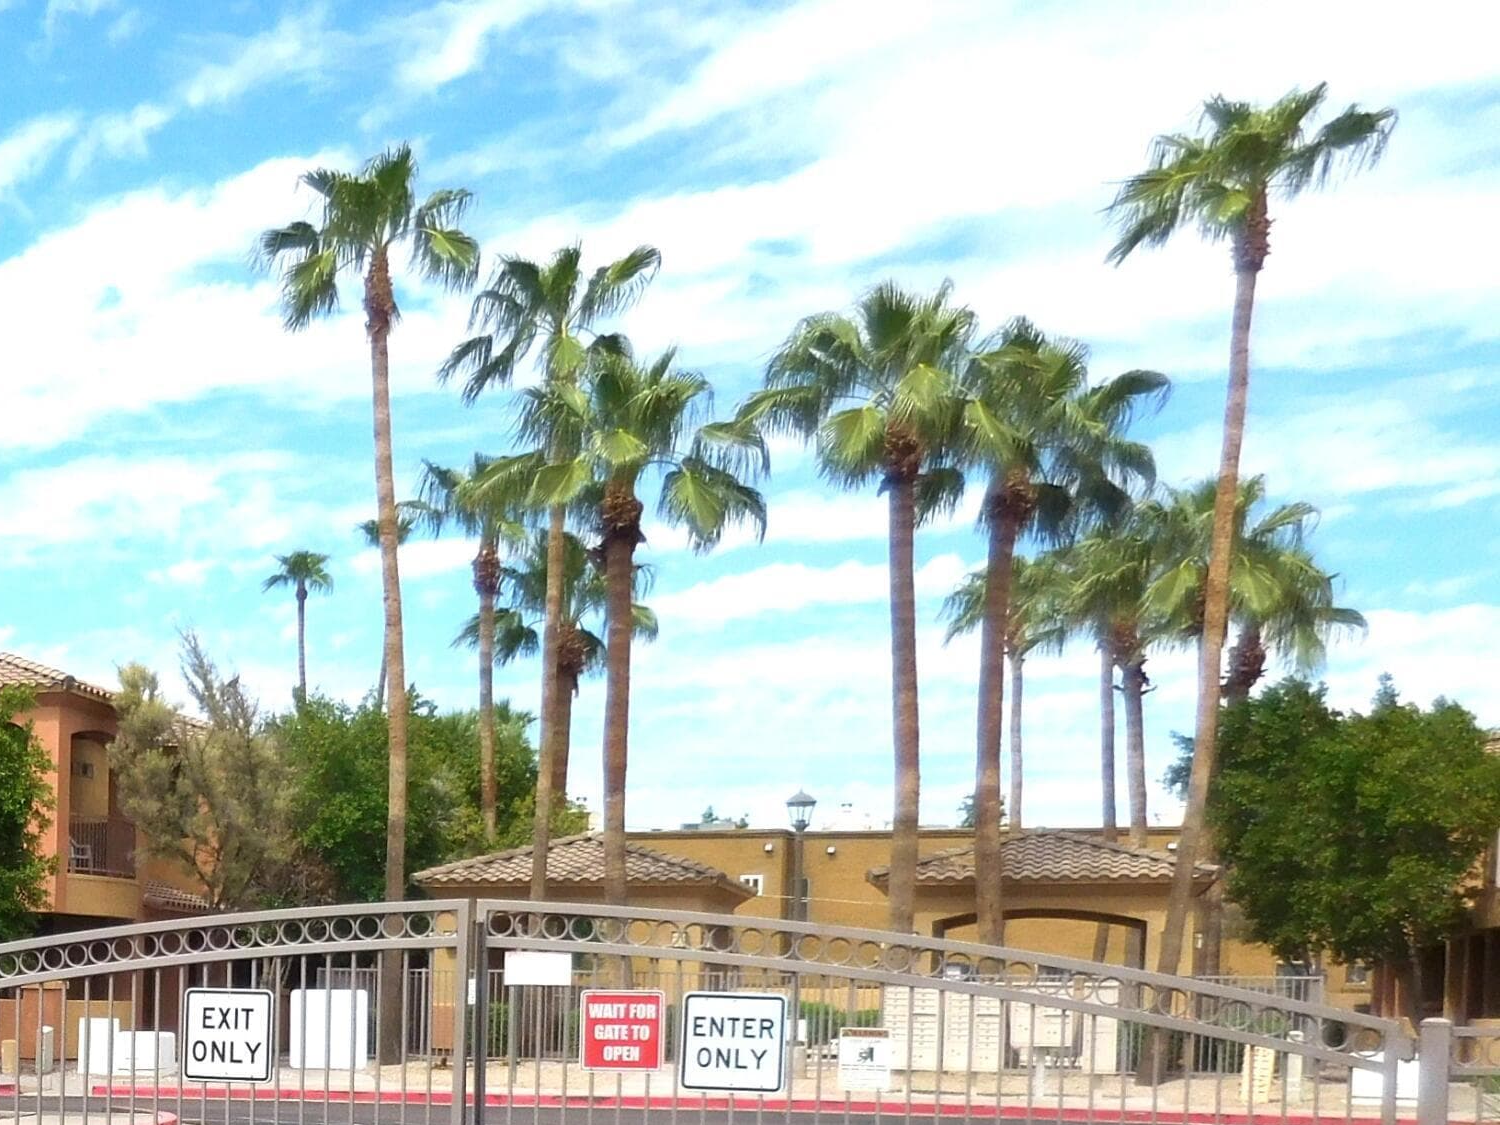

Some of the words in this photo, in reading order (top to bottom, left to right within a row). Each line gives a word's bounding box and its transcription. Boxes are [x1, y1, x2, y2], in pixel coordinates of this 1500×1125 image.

[202, 1007, 255, 1030] EXIT
[588, 1003, 627, 1019] WAIT
[629, 1003, 657, 1019] FOR
[594, 1024, 629, 1040] GATE
[630, 1025, 650, 1041] TO
[693, 1016, 774, 1039] ENTER
[192, 1040, 262, 1064] ONLY
[602, 1045, 640, 1062] OPEN
[697, 1047, 768, 1070] ONLY
